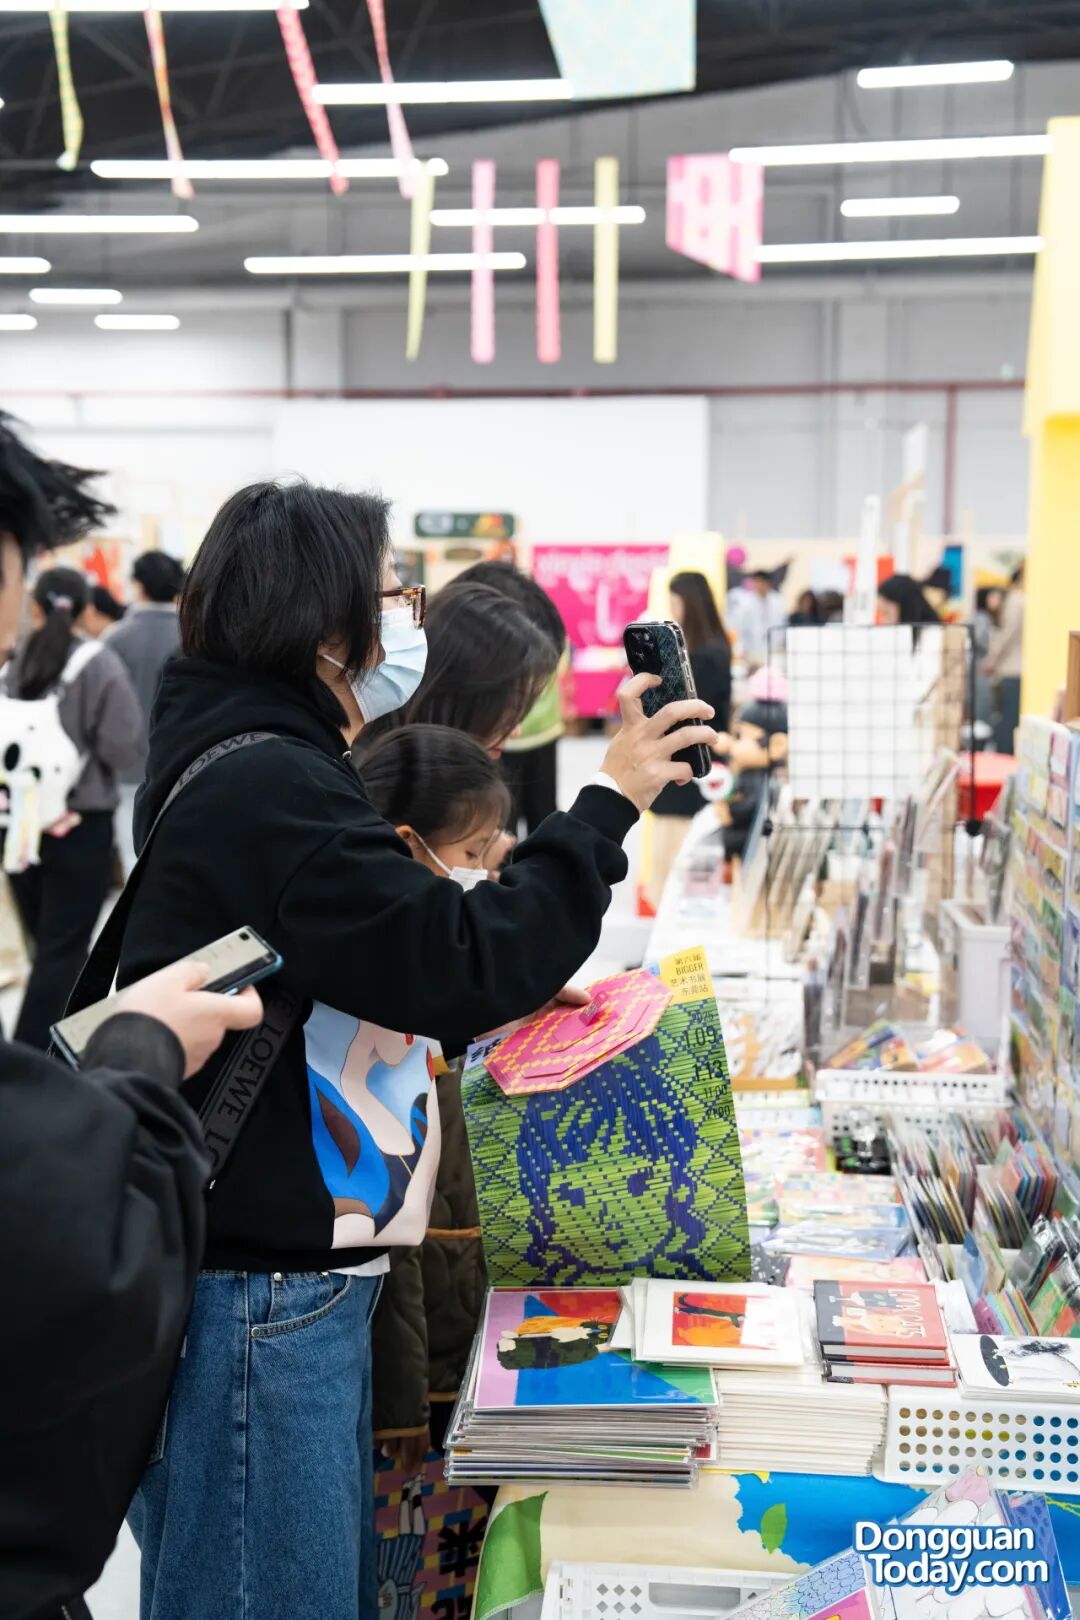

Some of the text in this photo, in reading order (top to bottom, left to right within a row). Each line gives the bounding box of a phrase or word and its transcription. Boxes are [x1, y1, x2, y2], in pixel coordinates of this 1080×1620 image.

[180, 733, 265, 785] LOEWE
[676, 963, 704, 976] BIGGER
[683, 1025, 718, 1050] 1.09
[218, 1022, 284, 1124] LOEWE
[691, 1059, 725, 1083] 1.13
